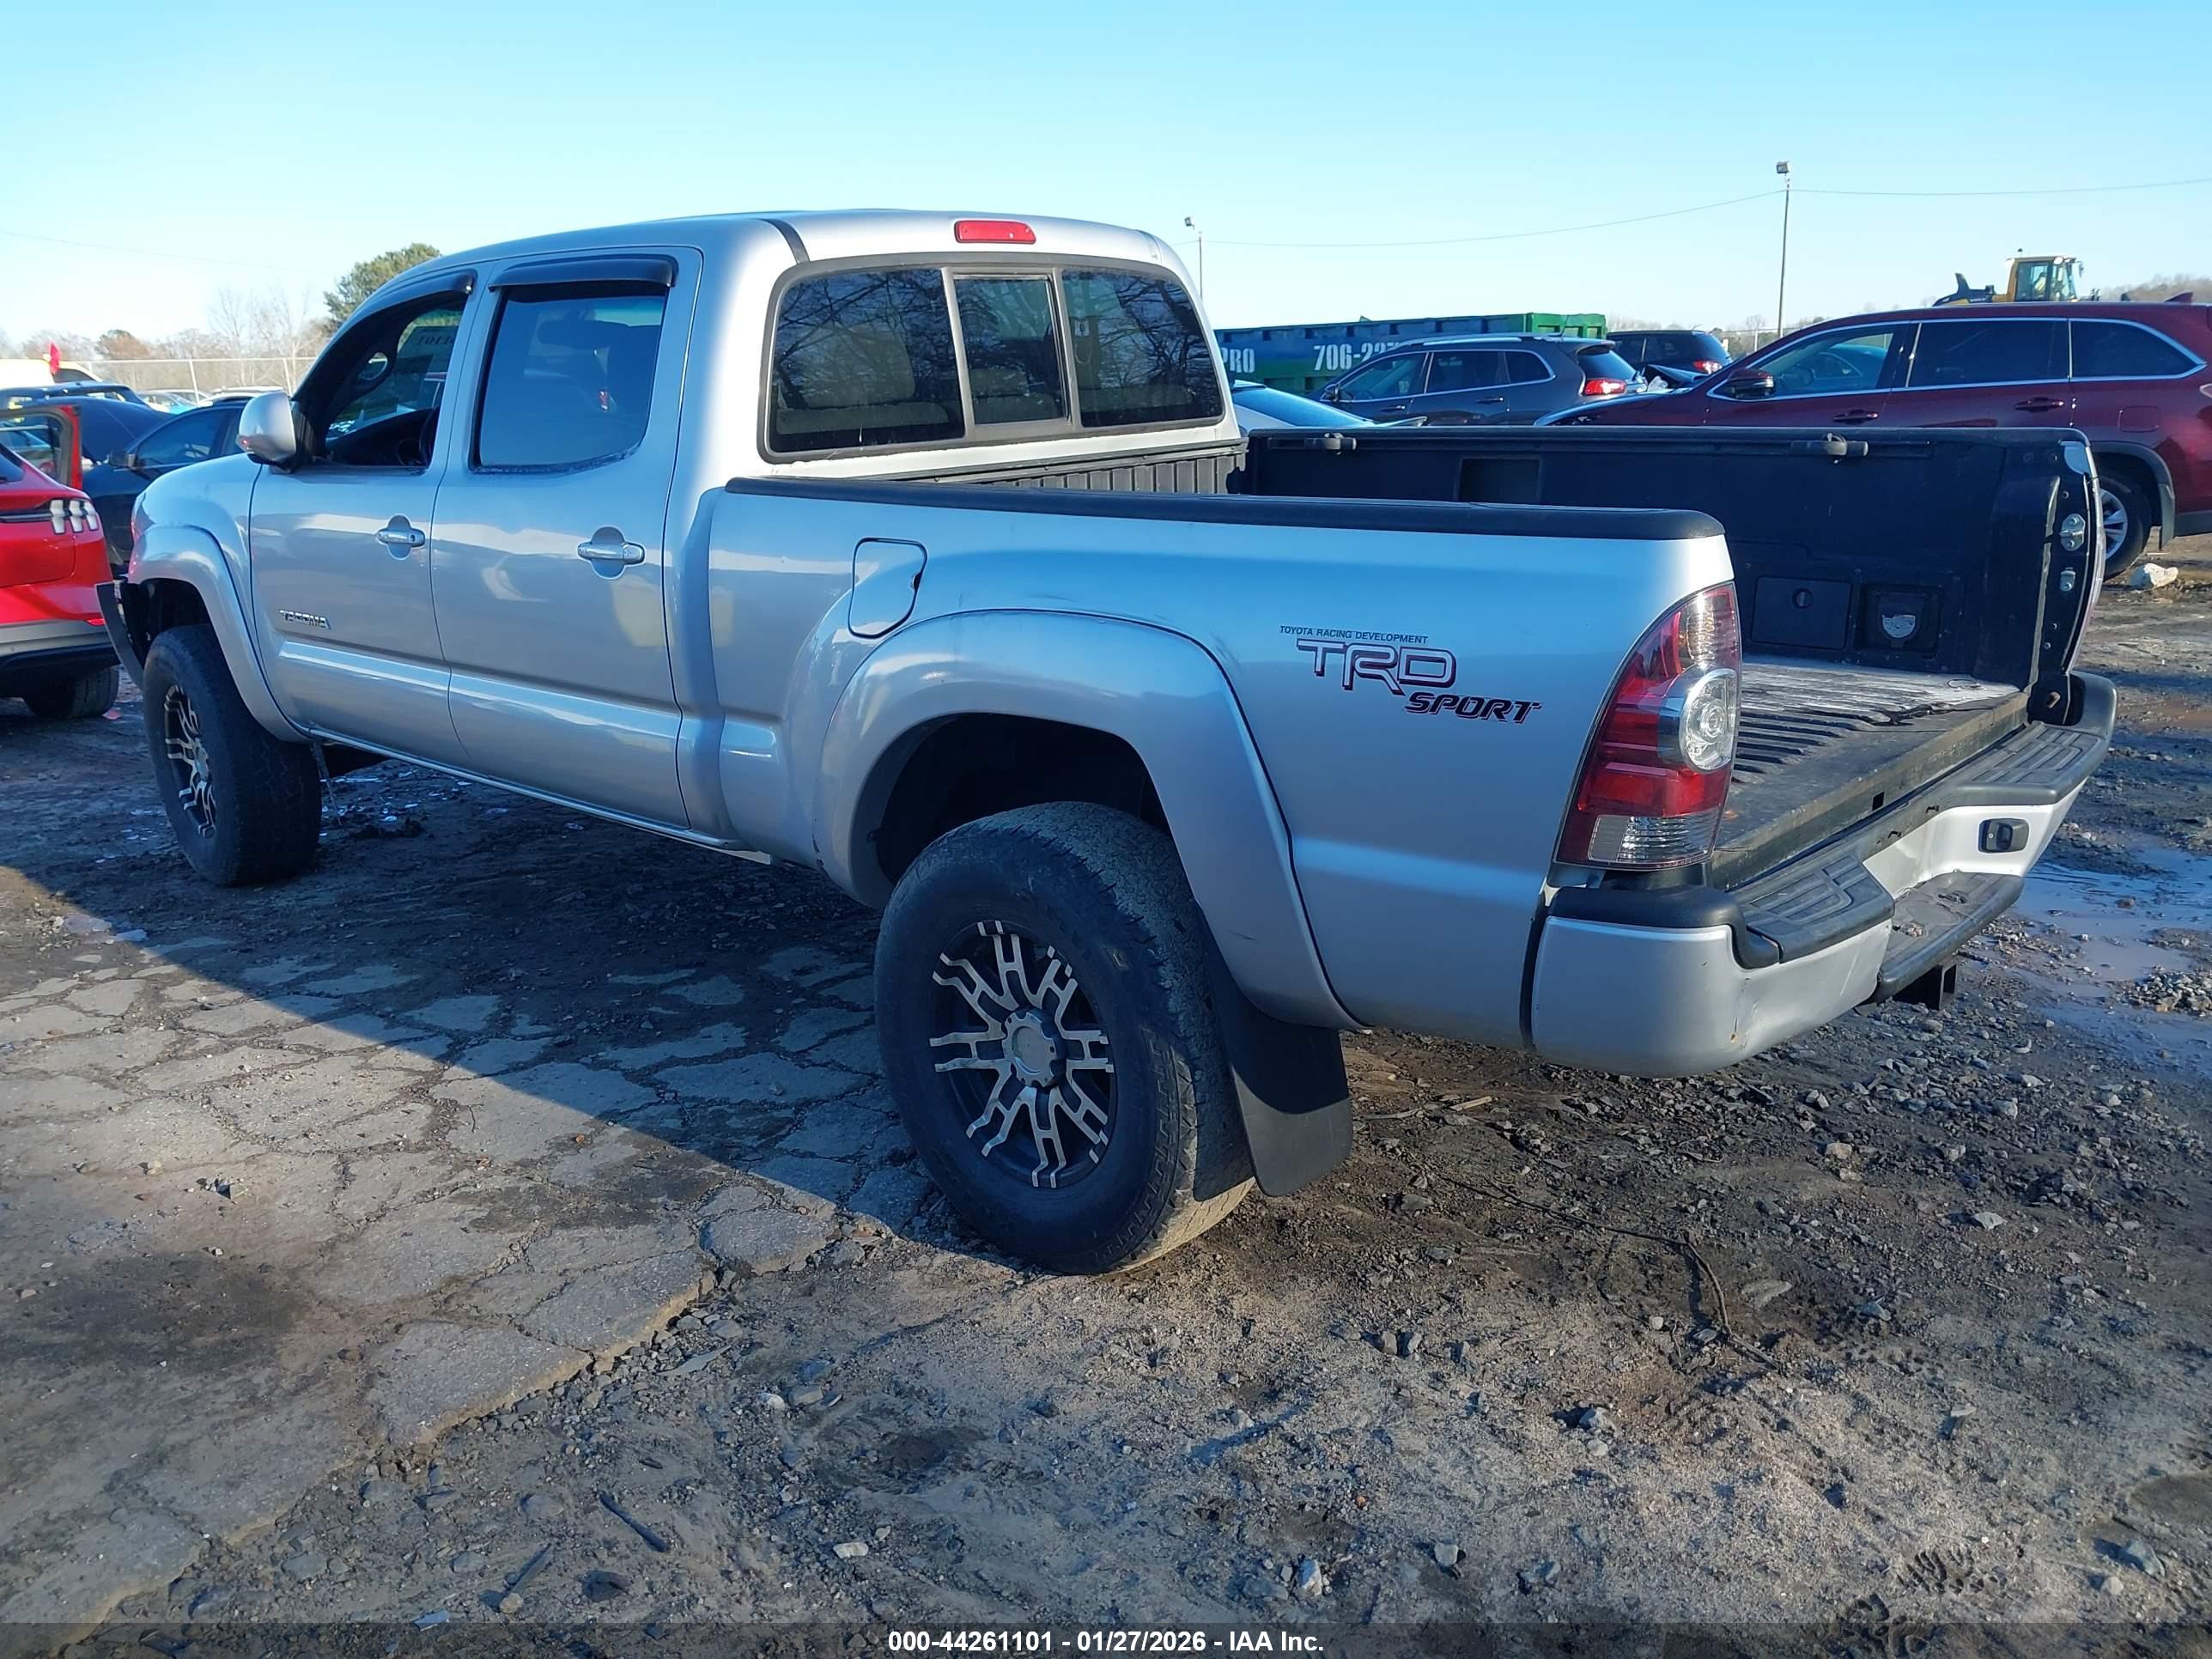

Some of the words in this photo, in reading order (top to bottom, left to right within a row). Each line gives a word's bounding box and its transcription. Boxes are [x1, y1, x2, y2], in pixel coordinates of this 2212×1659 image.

[1279, 625, 1313, 635] TOYOTA
[1316, 628, 1352, 639] RACING
[1356, 631, 1429, 645] DEVELOPMENT
[1296, 638, 1457, 696] TRD
[1403, 691, 1543, 724] SPORT
